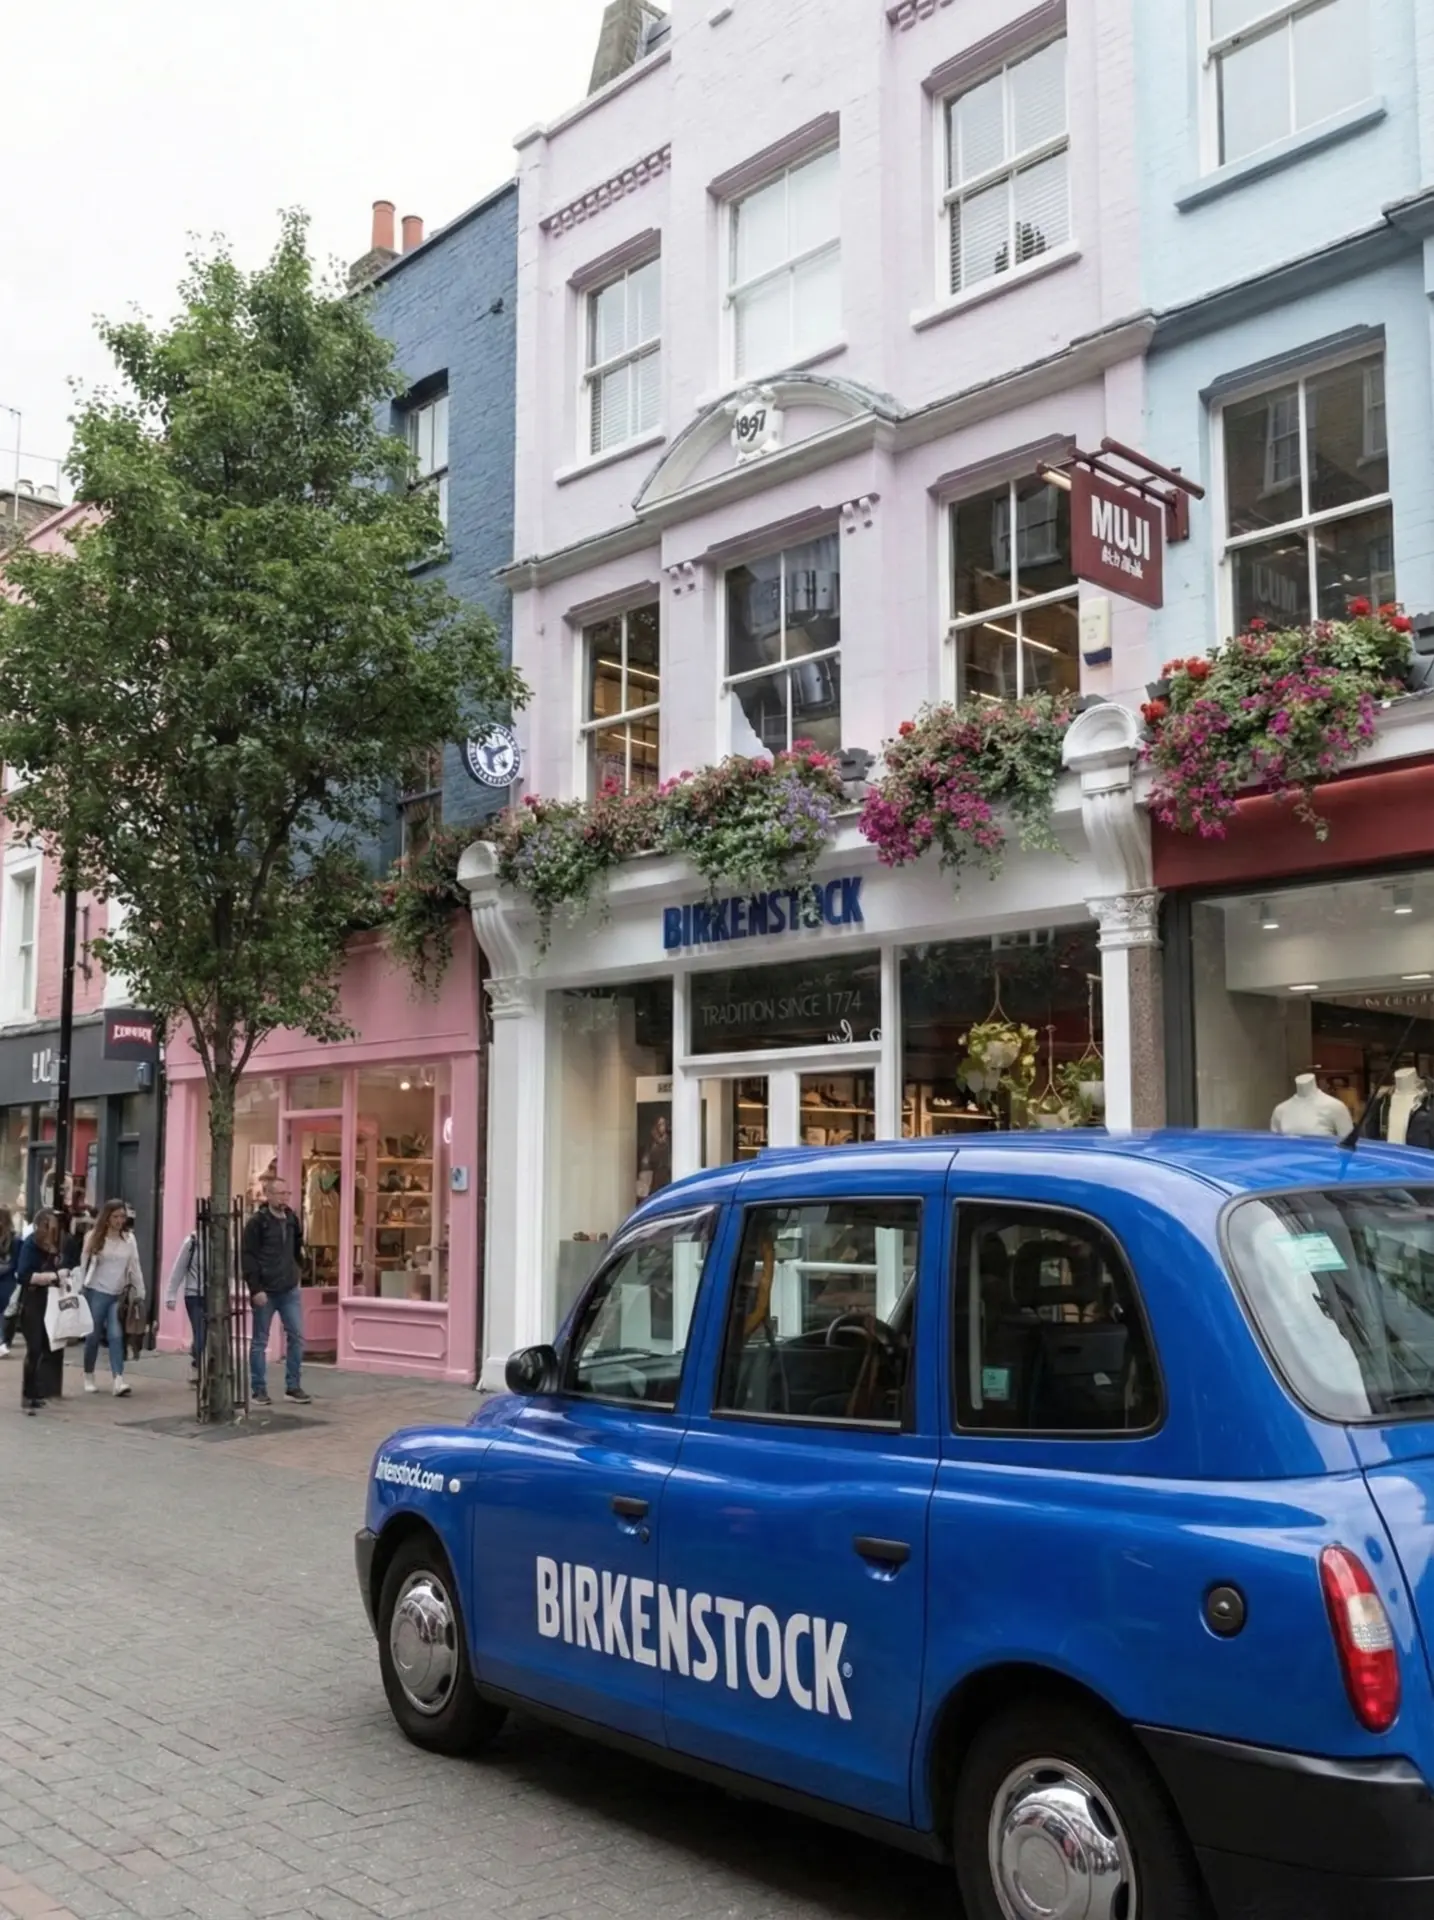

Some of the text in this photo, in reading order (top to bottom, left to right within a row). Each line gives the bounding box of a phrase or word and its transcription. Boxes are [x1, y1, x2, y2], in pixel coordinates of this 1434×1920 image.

[735, 408, 767, 443] 1897
[1091, 495, 1150, 561] MUJI
[701, 989, 863, 1026] TRADITION SINCE 1774
[536, 1555, 853, 1721] BIRKENSTOCK
